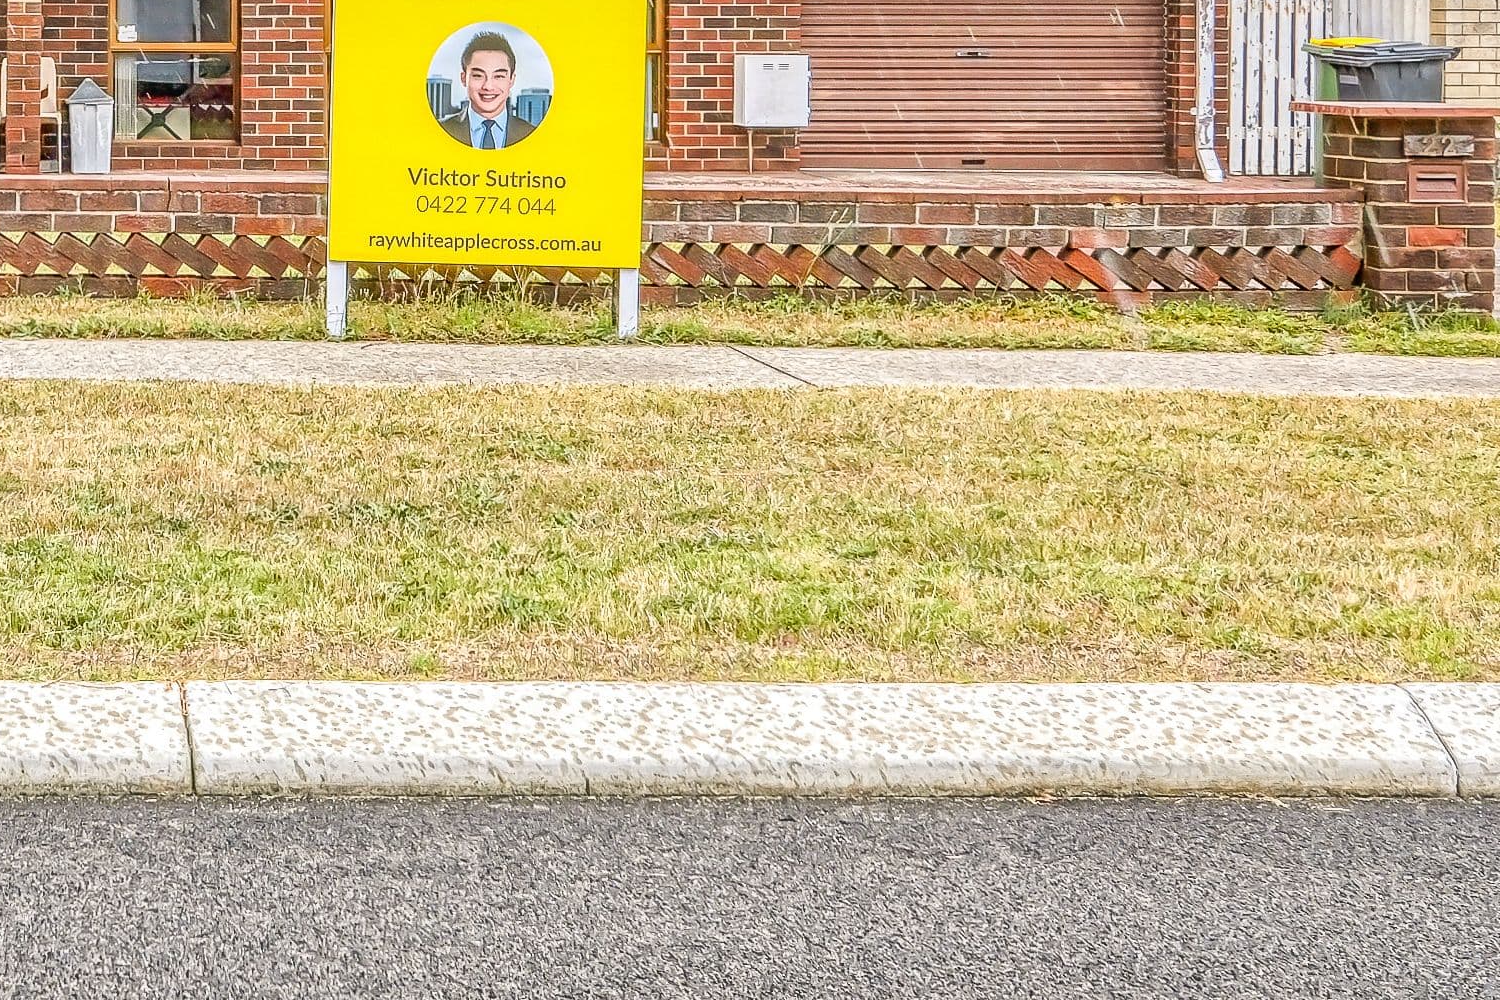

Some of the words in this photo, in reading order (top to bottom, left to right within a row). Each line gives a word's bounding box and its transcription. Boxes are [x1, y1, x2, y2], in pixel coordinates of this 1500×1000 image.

[1422, 135, 1457, 156] 22
[407, 167, 481, 187] Vicktor
[485, 169, 567, 189] Sutrisno
[416, 195, 468, 213] 0422
[474, 196, 512, 215] 774
[517, 197, 557, 216] 044
[369, 231, 602, 252] raywhiteapplecross.com.au
